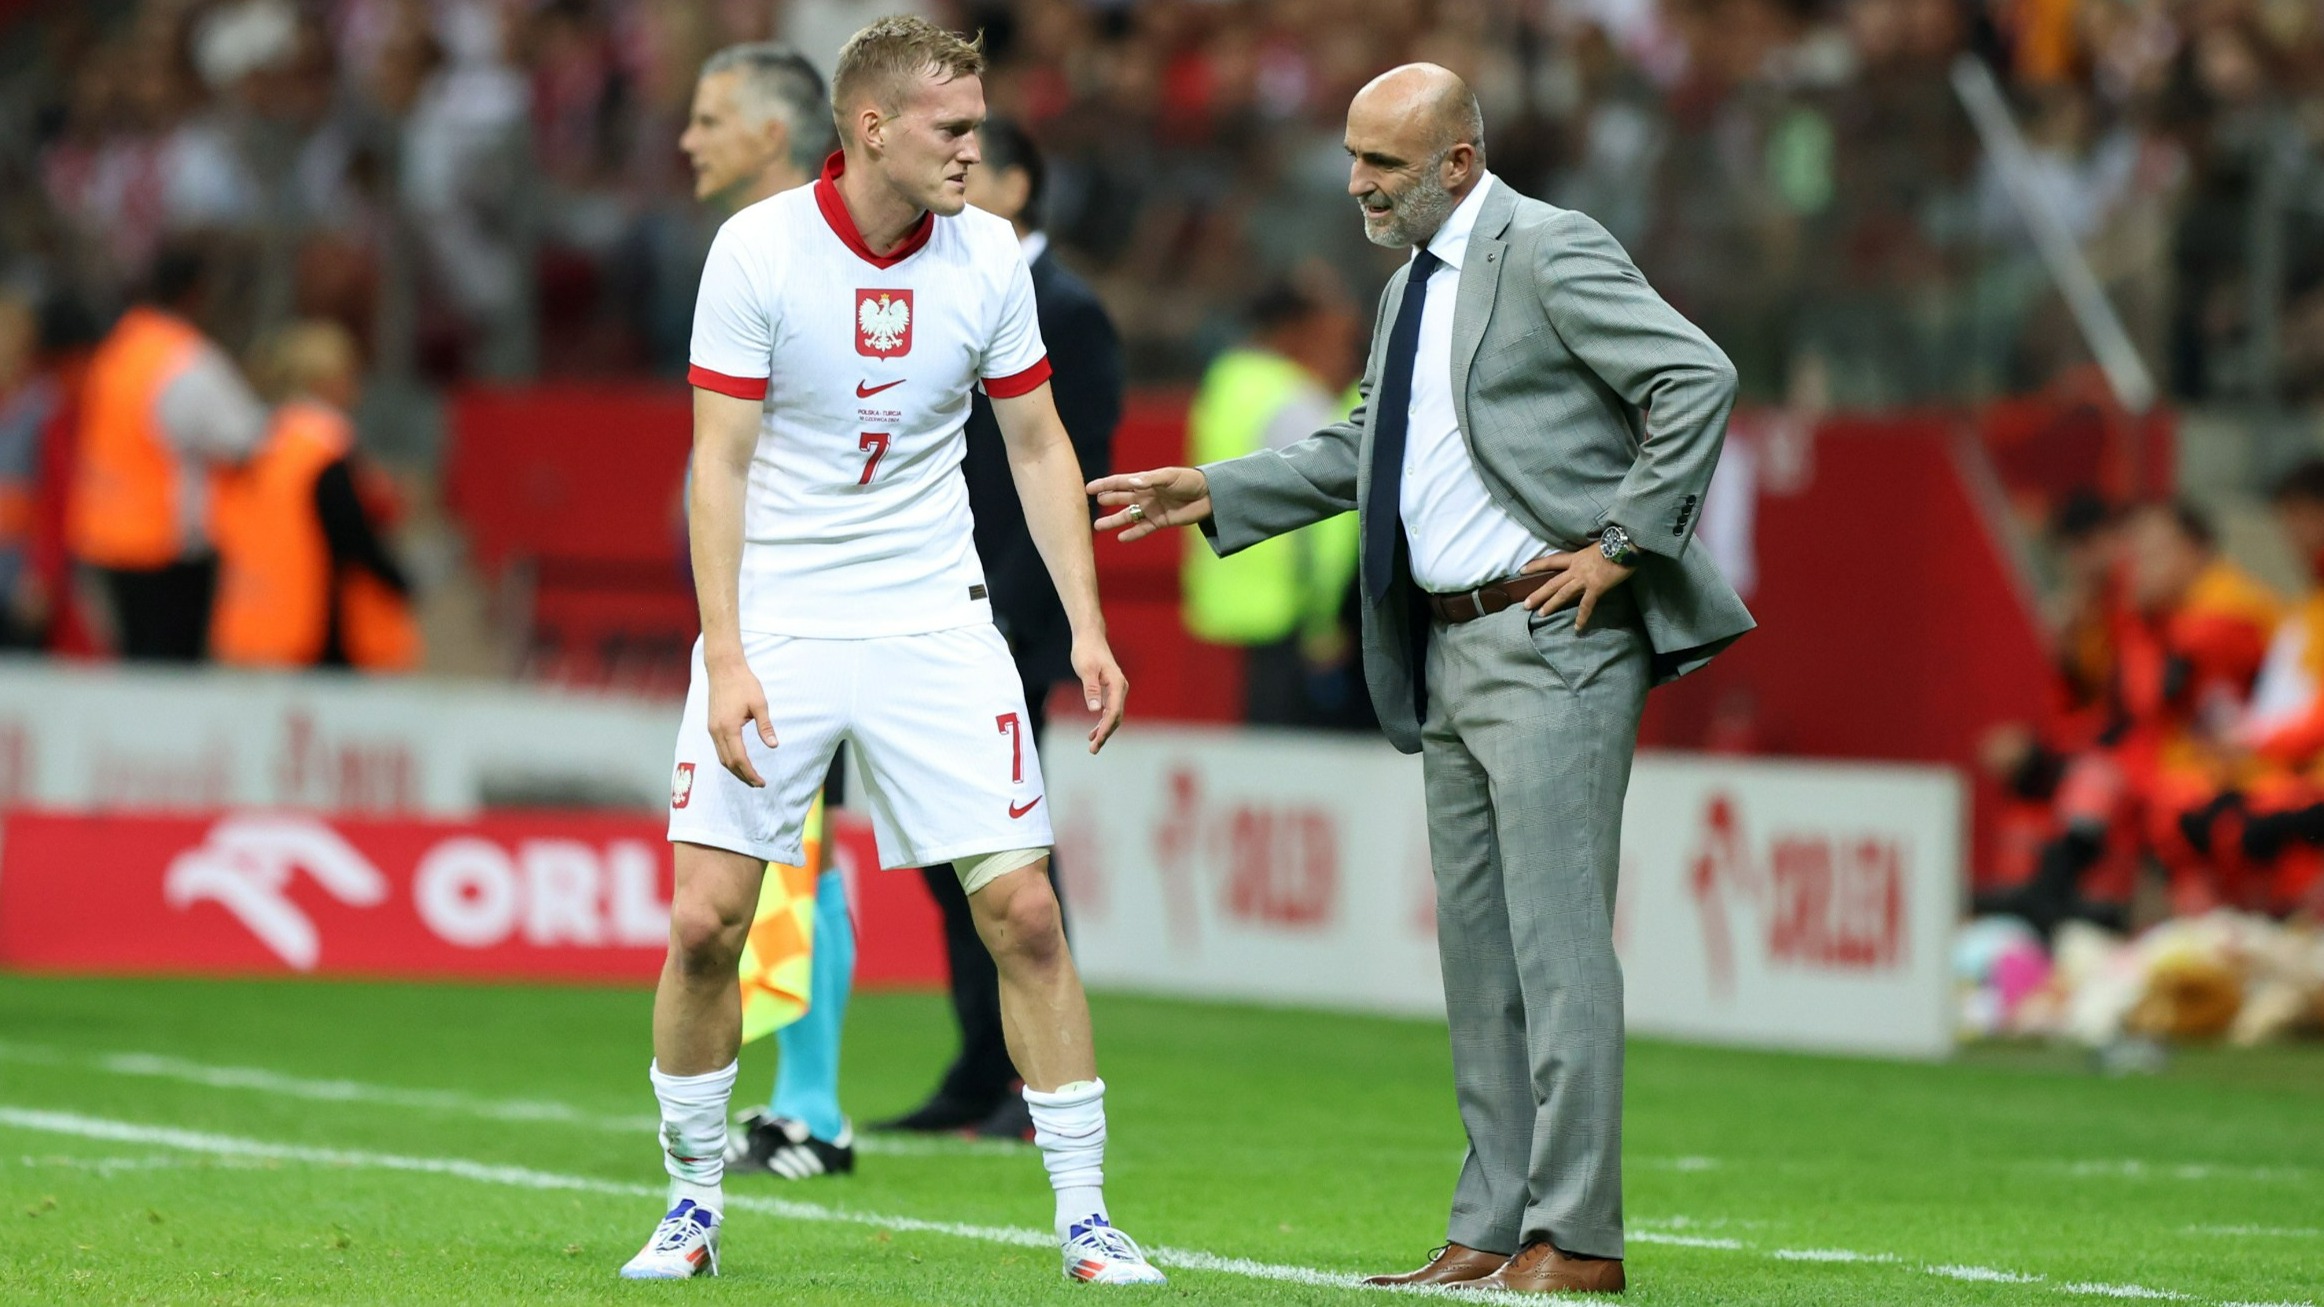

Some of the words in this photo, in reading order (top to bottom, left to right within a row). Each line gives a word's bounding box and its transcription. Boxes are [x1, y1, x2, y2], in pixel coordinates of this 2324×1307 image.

[859, 432, 891, 485] 7
[995, 712, 1024, 784] 7
[411, 836, 674, 947] ORL
